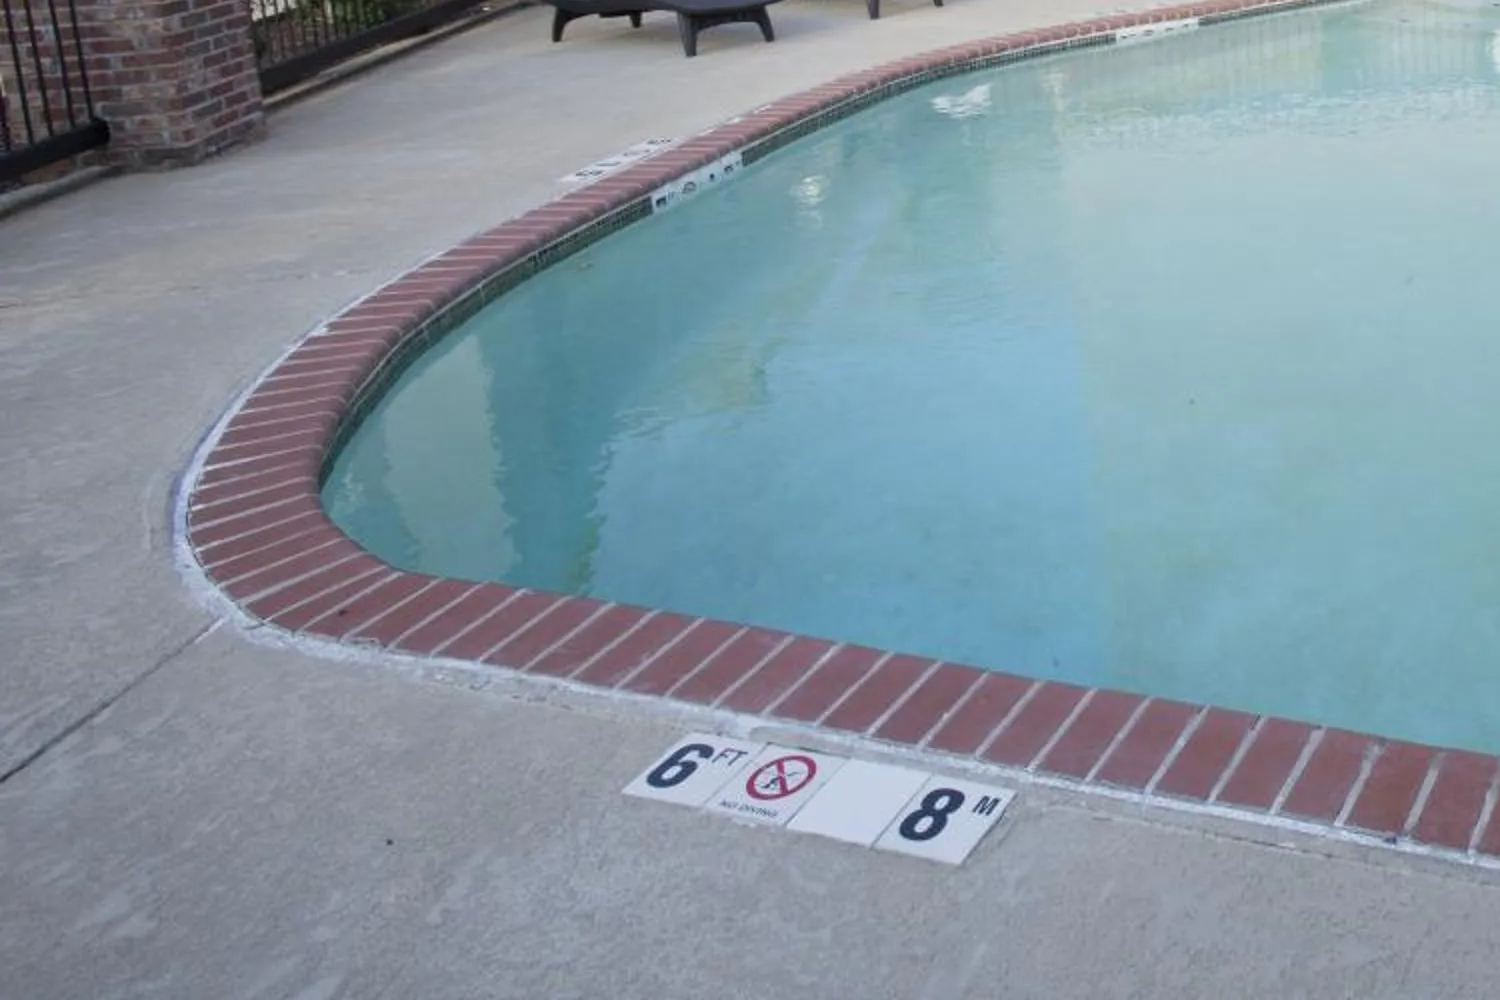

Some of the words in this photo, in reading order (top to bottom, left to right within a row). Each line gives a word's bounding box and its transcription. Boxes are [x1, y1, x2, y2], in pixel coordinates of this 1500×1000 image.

[645, 742, 715, 789] 6
[711, 747, 749, 767] FT
[898, 787, 966, 842] 8
[972, 795, 1000, 817] M
